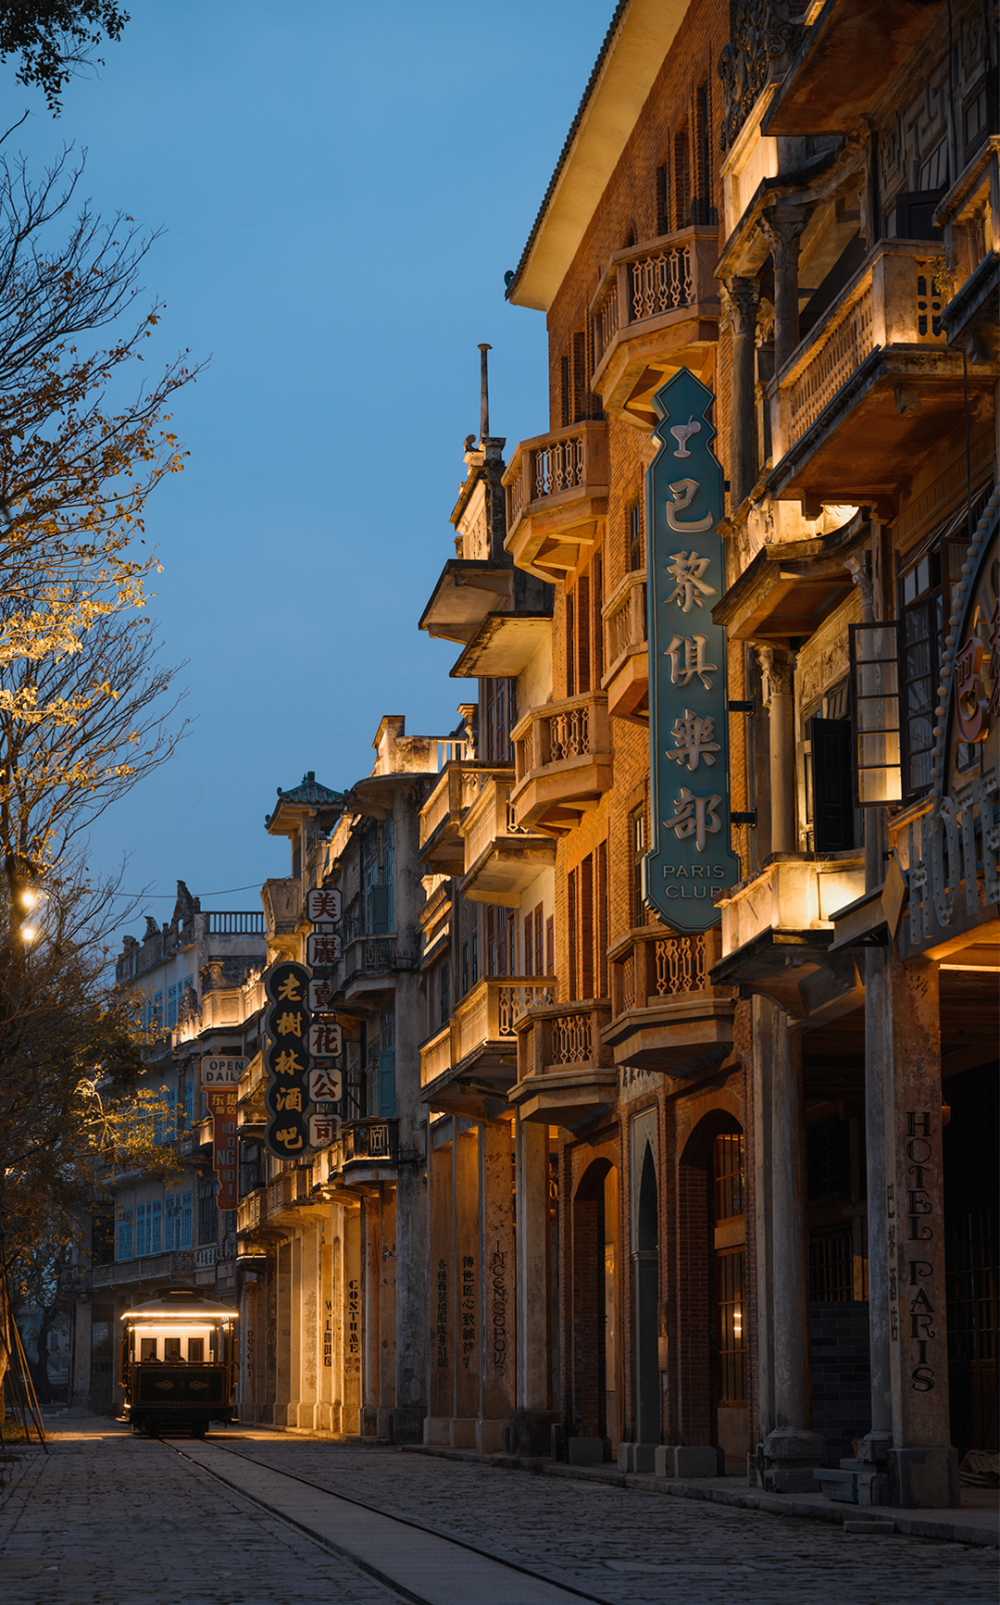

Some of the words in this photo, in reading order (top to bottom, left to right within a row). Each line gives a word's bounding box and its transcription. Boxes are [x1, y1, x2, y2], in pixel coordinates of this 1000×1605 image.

[662, 477, 721, 851] 巴黎俱樂部
[662, 864, 725, 879] PARIS
[206, 1072, 242, 1082] DAIL
[209, 1061, 244, 1071] OPEN
[274, 972, 304, 1150] 老樹林酒吧
[905, 1111, 933, 1241] HOTEL
[348, 1279, 359, 1353] COSTUME
[908, 1260, 936, 1392] PARIS
